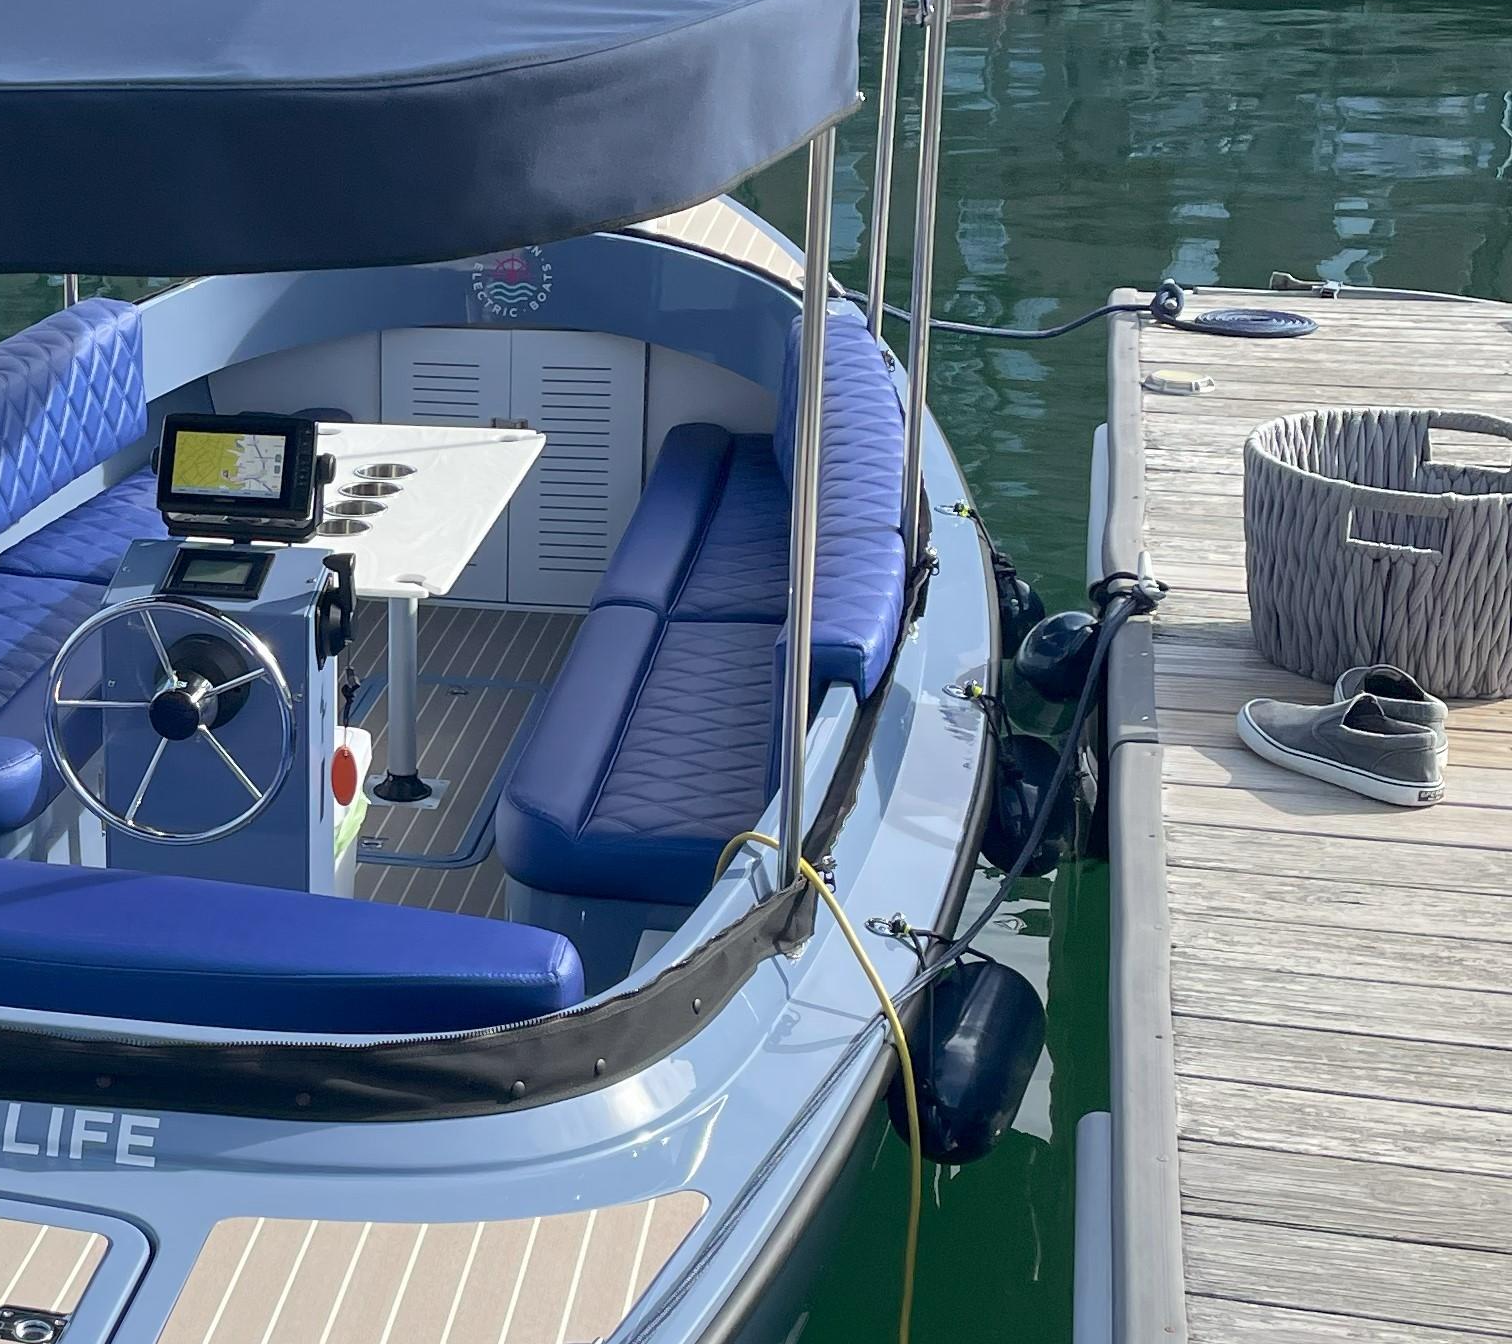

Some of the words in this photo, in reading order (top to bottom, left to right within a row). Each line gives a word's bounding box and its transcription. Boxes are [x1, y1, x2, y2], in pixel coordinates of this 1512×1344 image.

[472, 262, 519, 317] ELECTRIC
[529, 263, 553, 311] BOATS
[3, 1102, 161, 1168] LIFE
